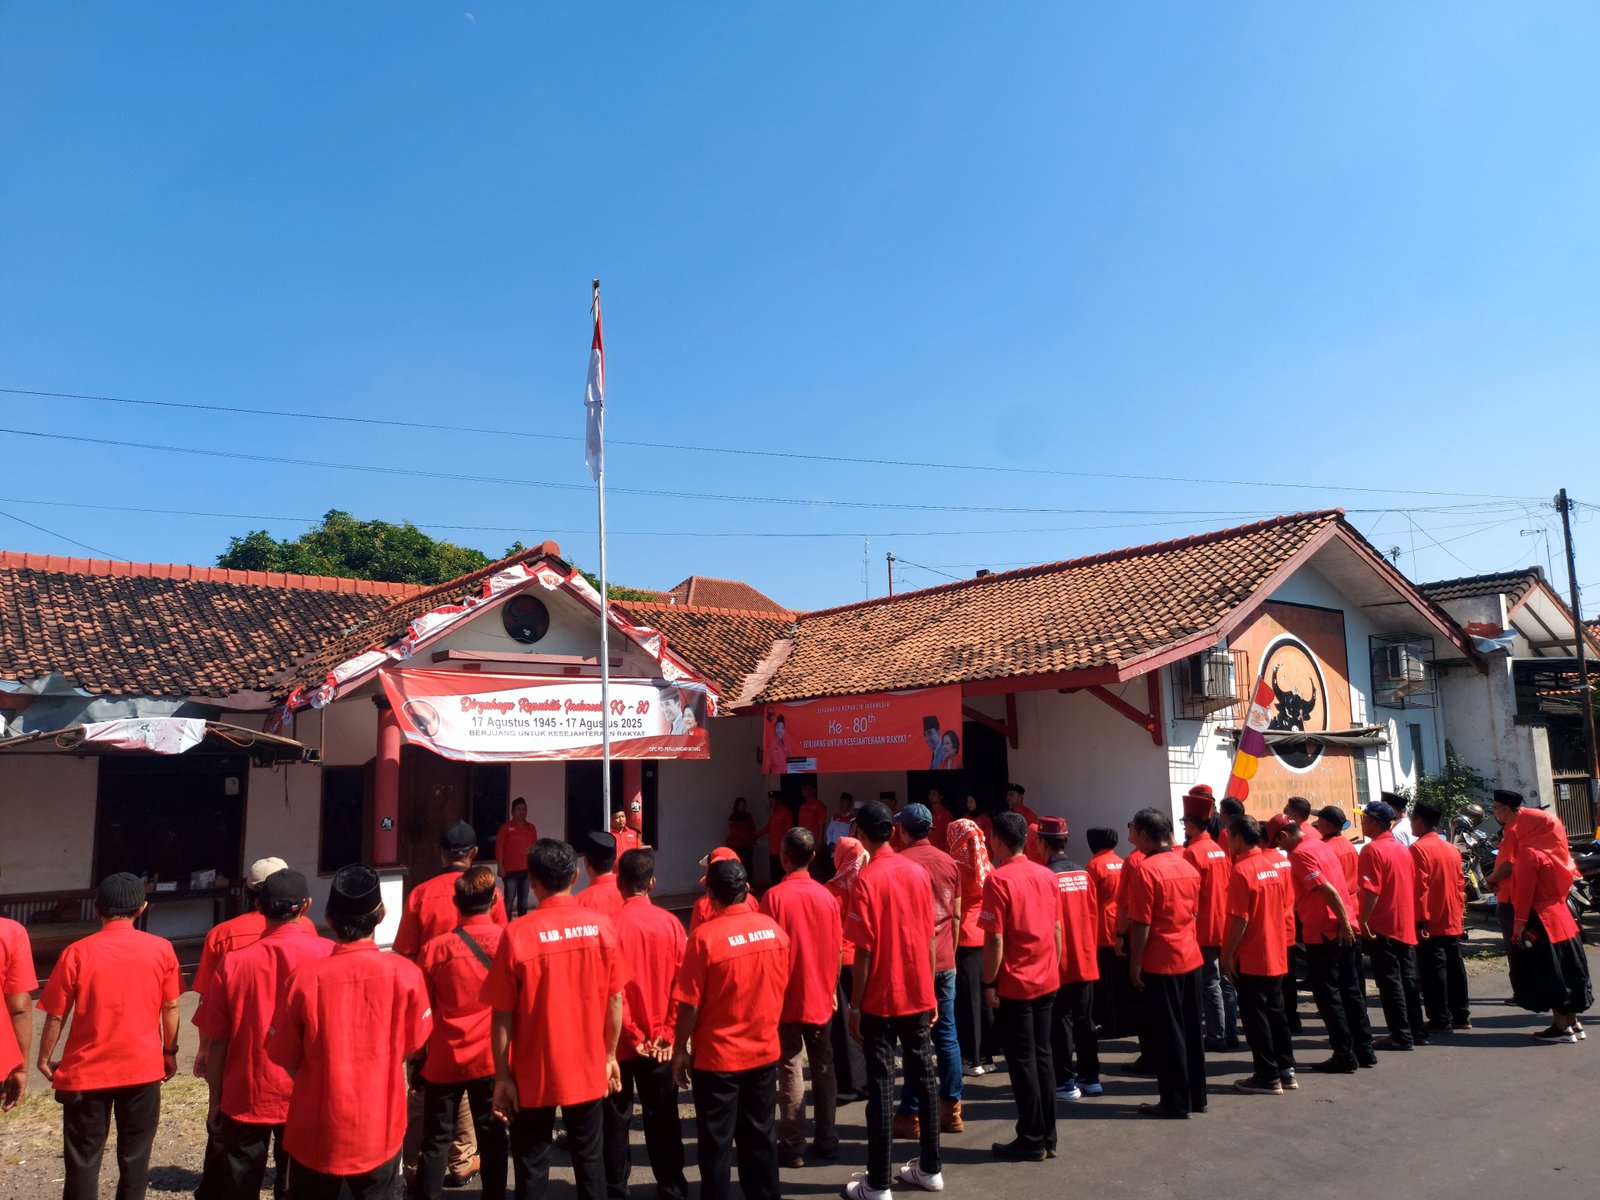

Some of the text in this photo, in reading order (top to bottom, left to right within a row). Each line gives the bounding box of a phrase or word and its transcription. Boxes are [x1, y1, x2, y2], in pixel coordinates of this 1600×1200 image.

[460, 696, 515, 715] Dirgahayu
[518, 697, 561, 715] Republik
[636, 700, 650, 715] 80
[471, 717, 483, 727] 17
[487, 717, 530, 730] Agustus
[534, 718, 556, 728] 1945
[565, 718, 577, 728] 17
[579, 718, 618, 730] Agusus
[621, 718, 642, 728] 2025
[828, 720, 842, 735] Ke
[886, 734, 907, 744] RAKYAT
[539, 925, 599, 943] KAB. BATANG
[728, 928, 775, 947] KAB. BATANG
